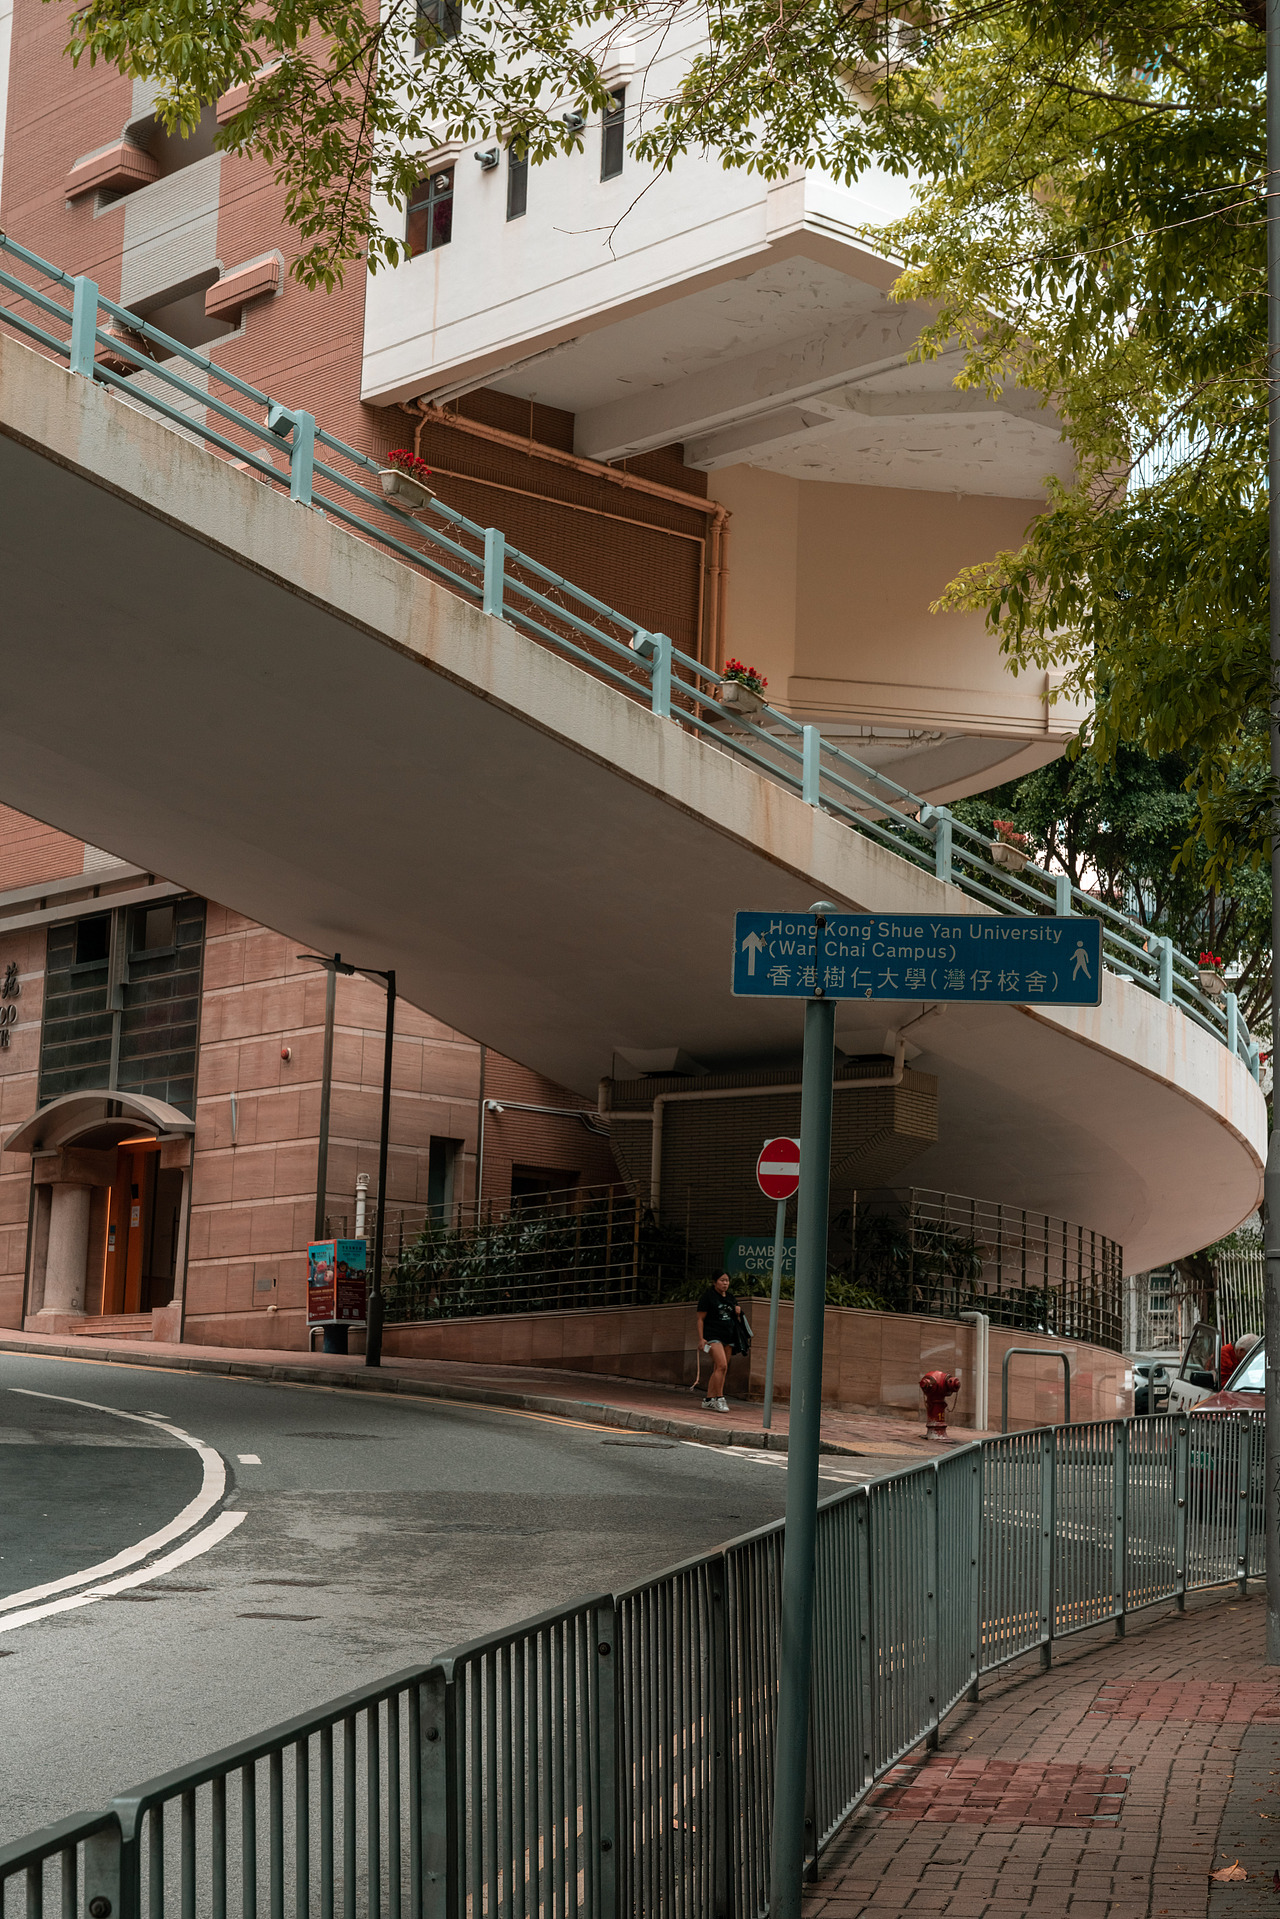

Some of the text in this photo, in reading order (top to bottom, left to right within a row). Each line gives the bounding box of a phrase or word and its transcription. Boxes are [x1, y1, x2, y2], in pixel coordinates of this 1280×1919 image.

[770, 920, 1063, 944] Hong Kong Shue Yan University
[769, 940, 956, 962] (Wan Chai Campus)
